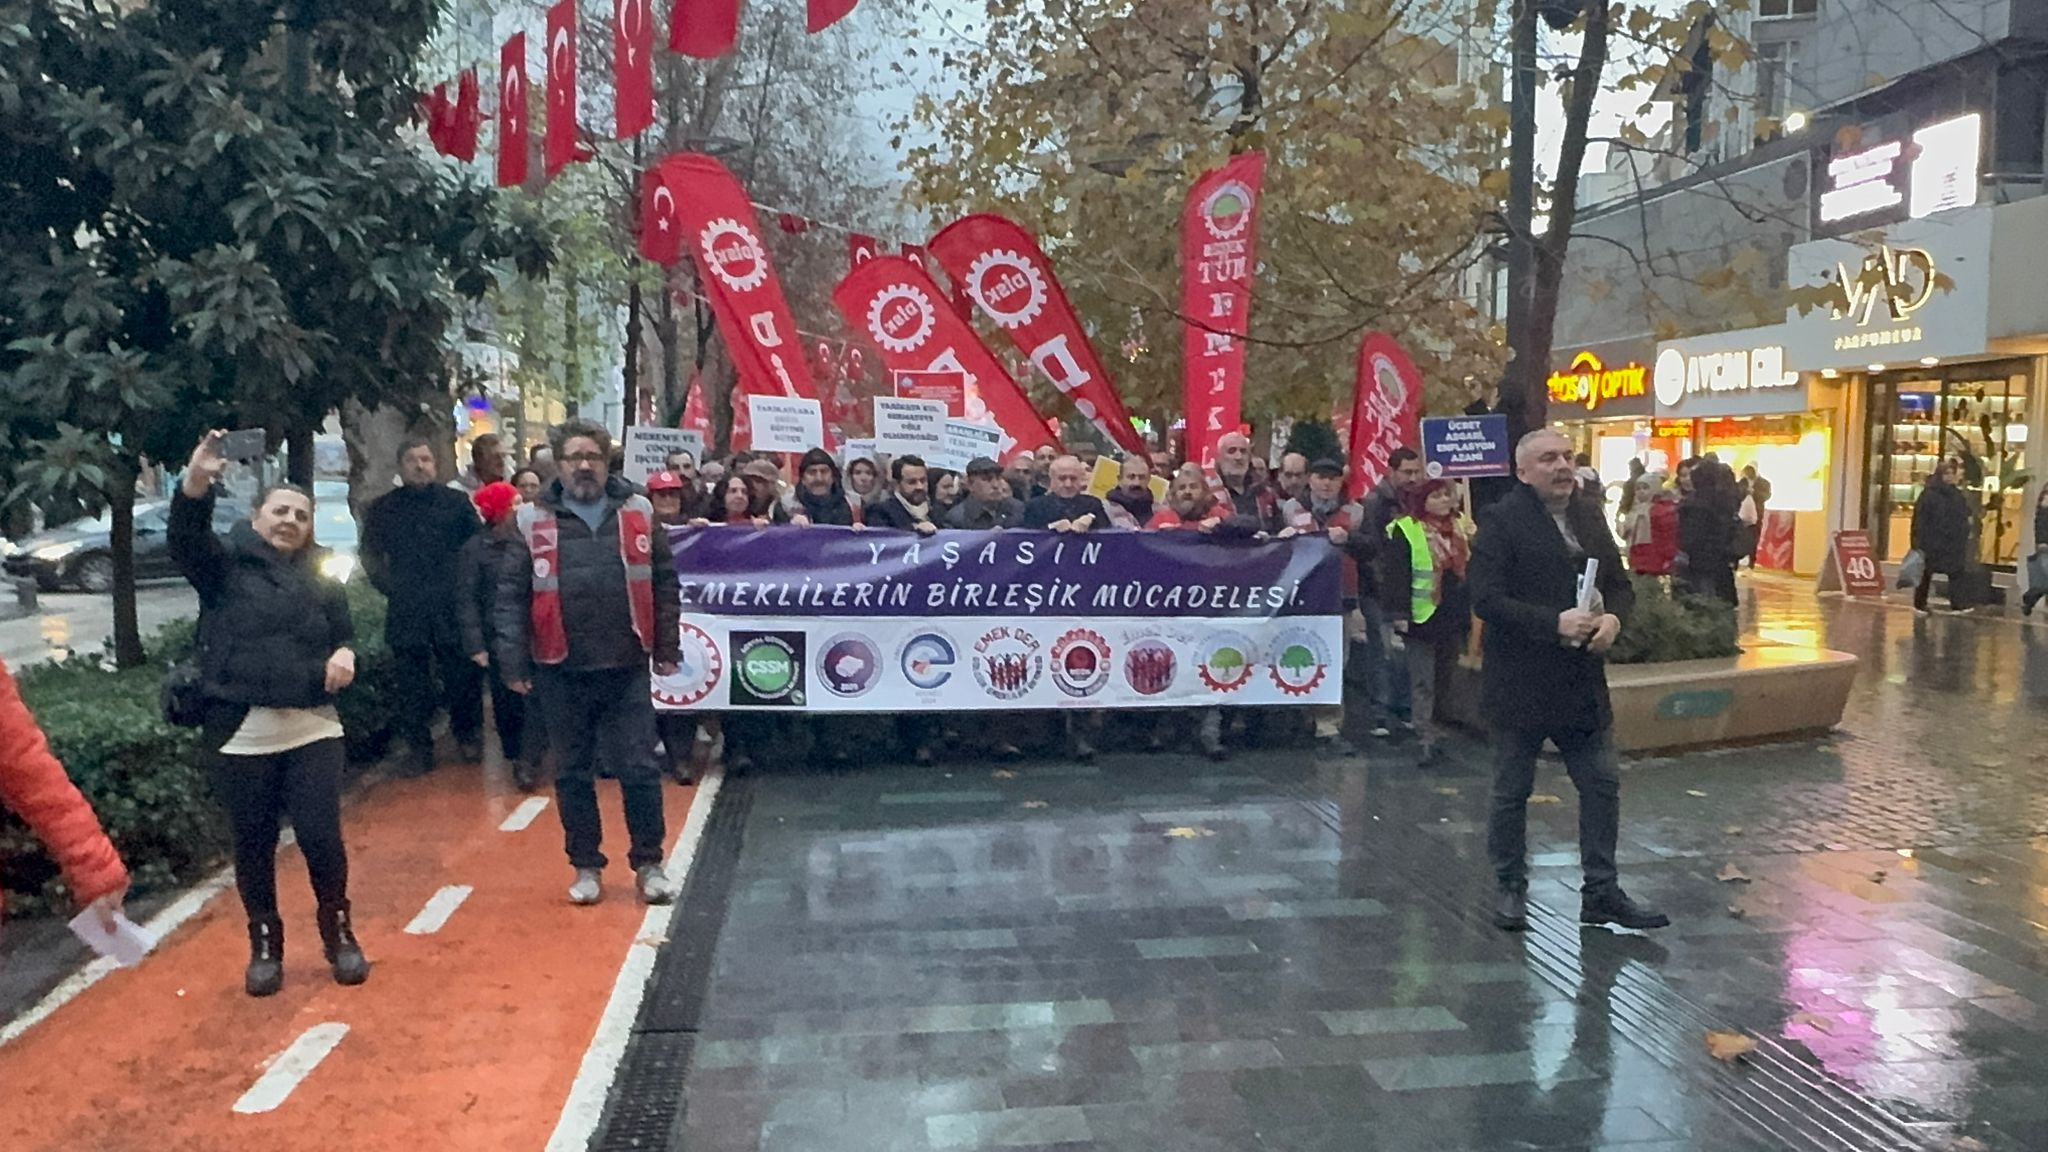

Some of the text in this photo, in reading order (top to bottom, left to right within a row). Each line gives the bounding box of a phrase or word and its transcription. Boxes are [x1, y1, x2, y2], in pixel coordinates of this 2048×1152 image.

[868, 541, 1102, 571] YAŞASIN
[1846, 555, 1876, 580] 40
[679, 576, 1305, 613] EMEKLİLERİN BİRLEŞİK MÜCADELESİ.
